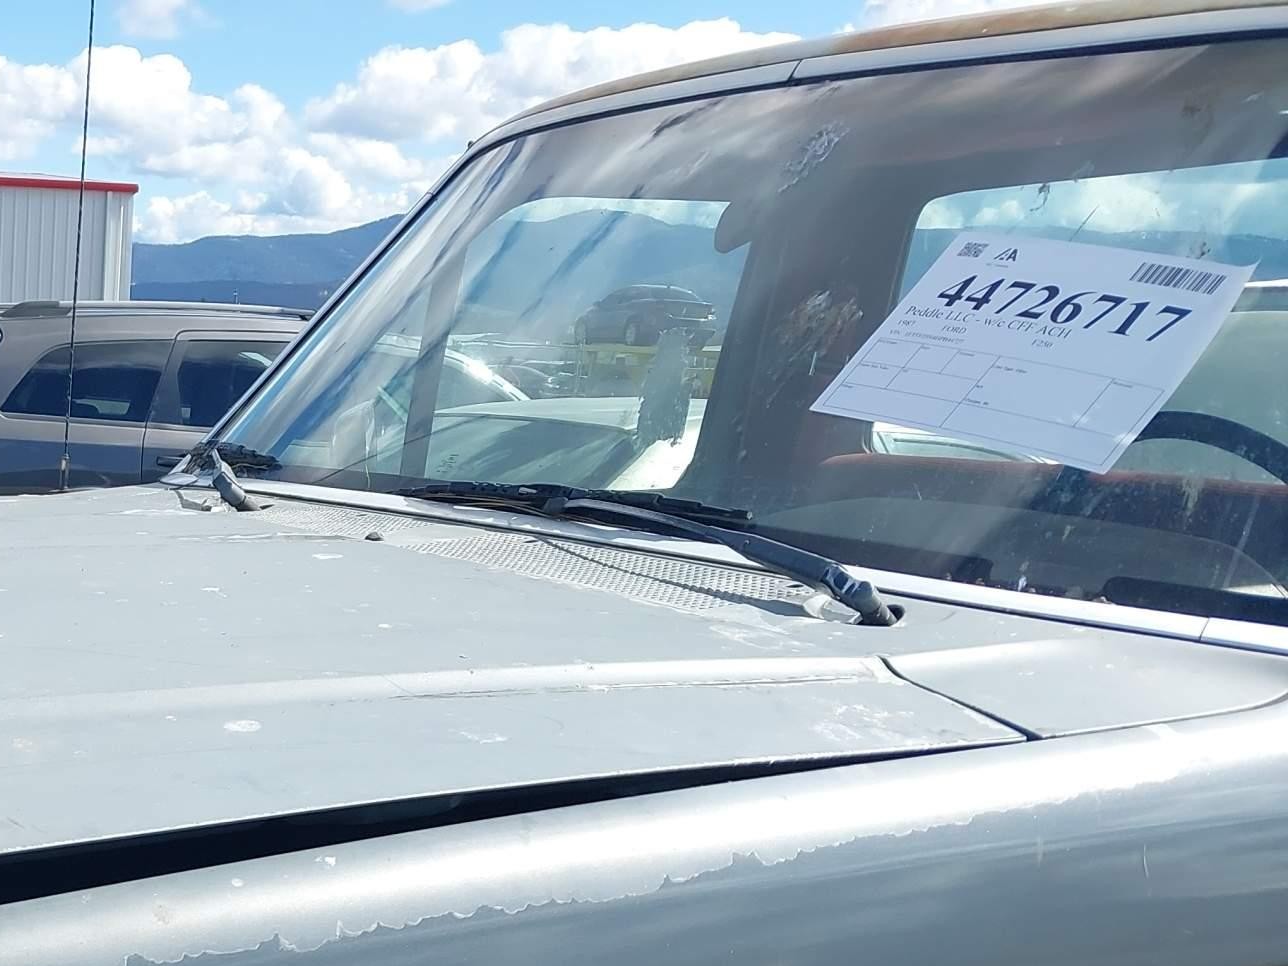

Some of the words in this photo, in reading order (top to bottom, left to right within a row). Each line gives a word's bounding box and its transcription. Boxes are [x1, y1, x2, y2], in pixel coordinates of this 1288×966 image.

[905, 306, 944, 319] Peddle
[945, 312, 976, 323] LLC
[1038, 325, 1073, 340] ACH
[937, 274, 1193, 342] 44726717
[941, 324, 967, 335] FORD
